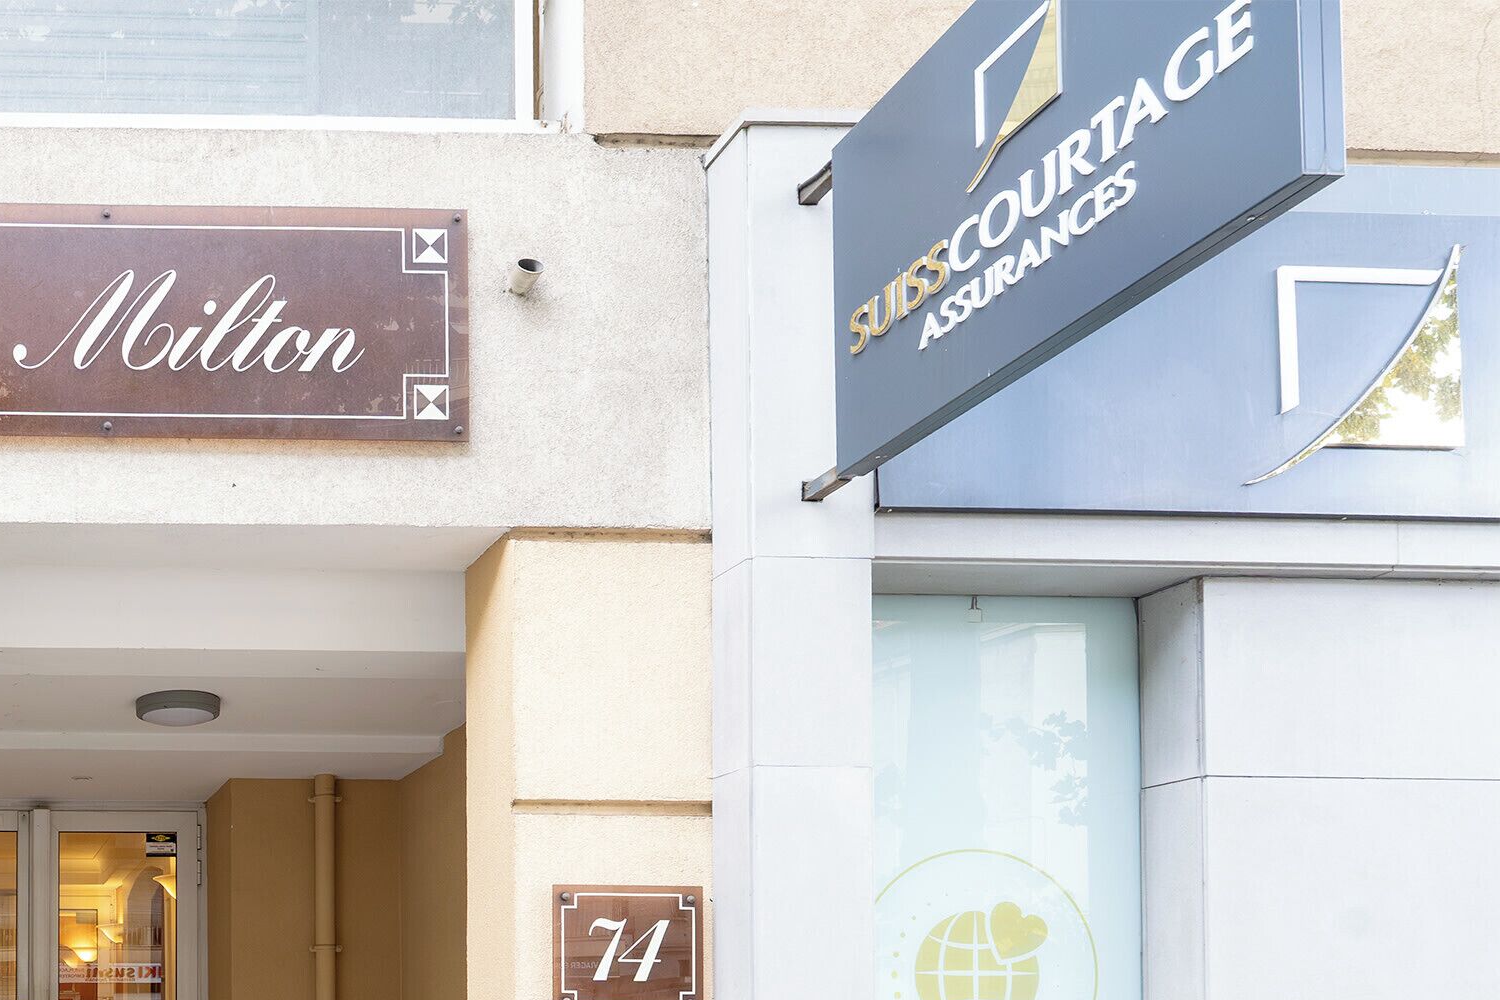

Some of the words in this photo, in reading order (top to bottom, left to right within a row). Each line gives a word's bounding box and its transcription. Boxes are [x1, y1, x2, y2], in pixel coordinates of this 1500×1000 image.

[918, 160, 1136, 350] ASSURANCES
[12, 269, 365, 373] Milton
[588, 917, 670, 982] 74
